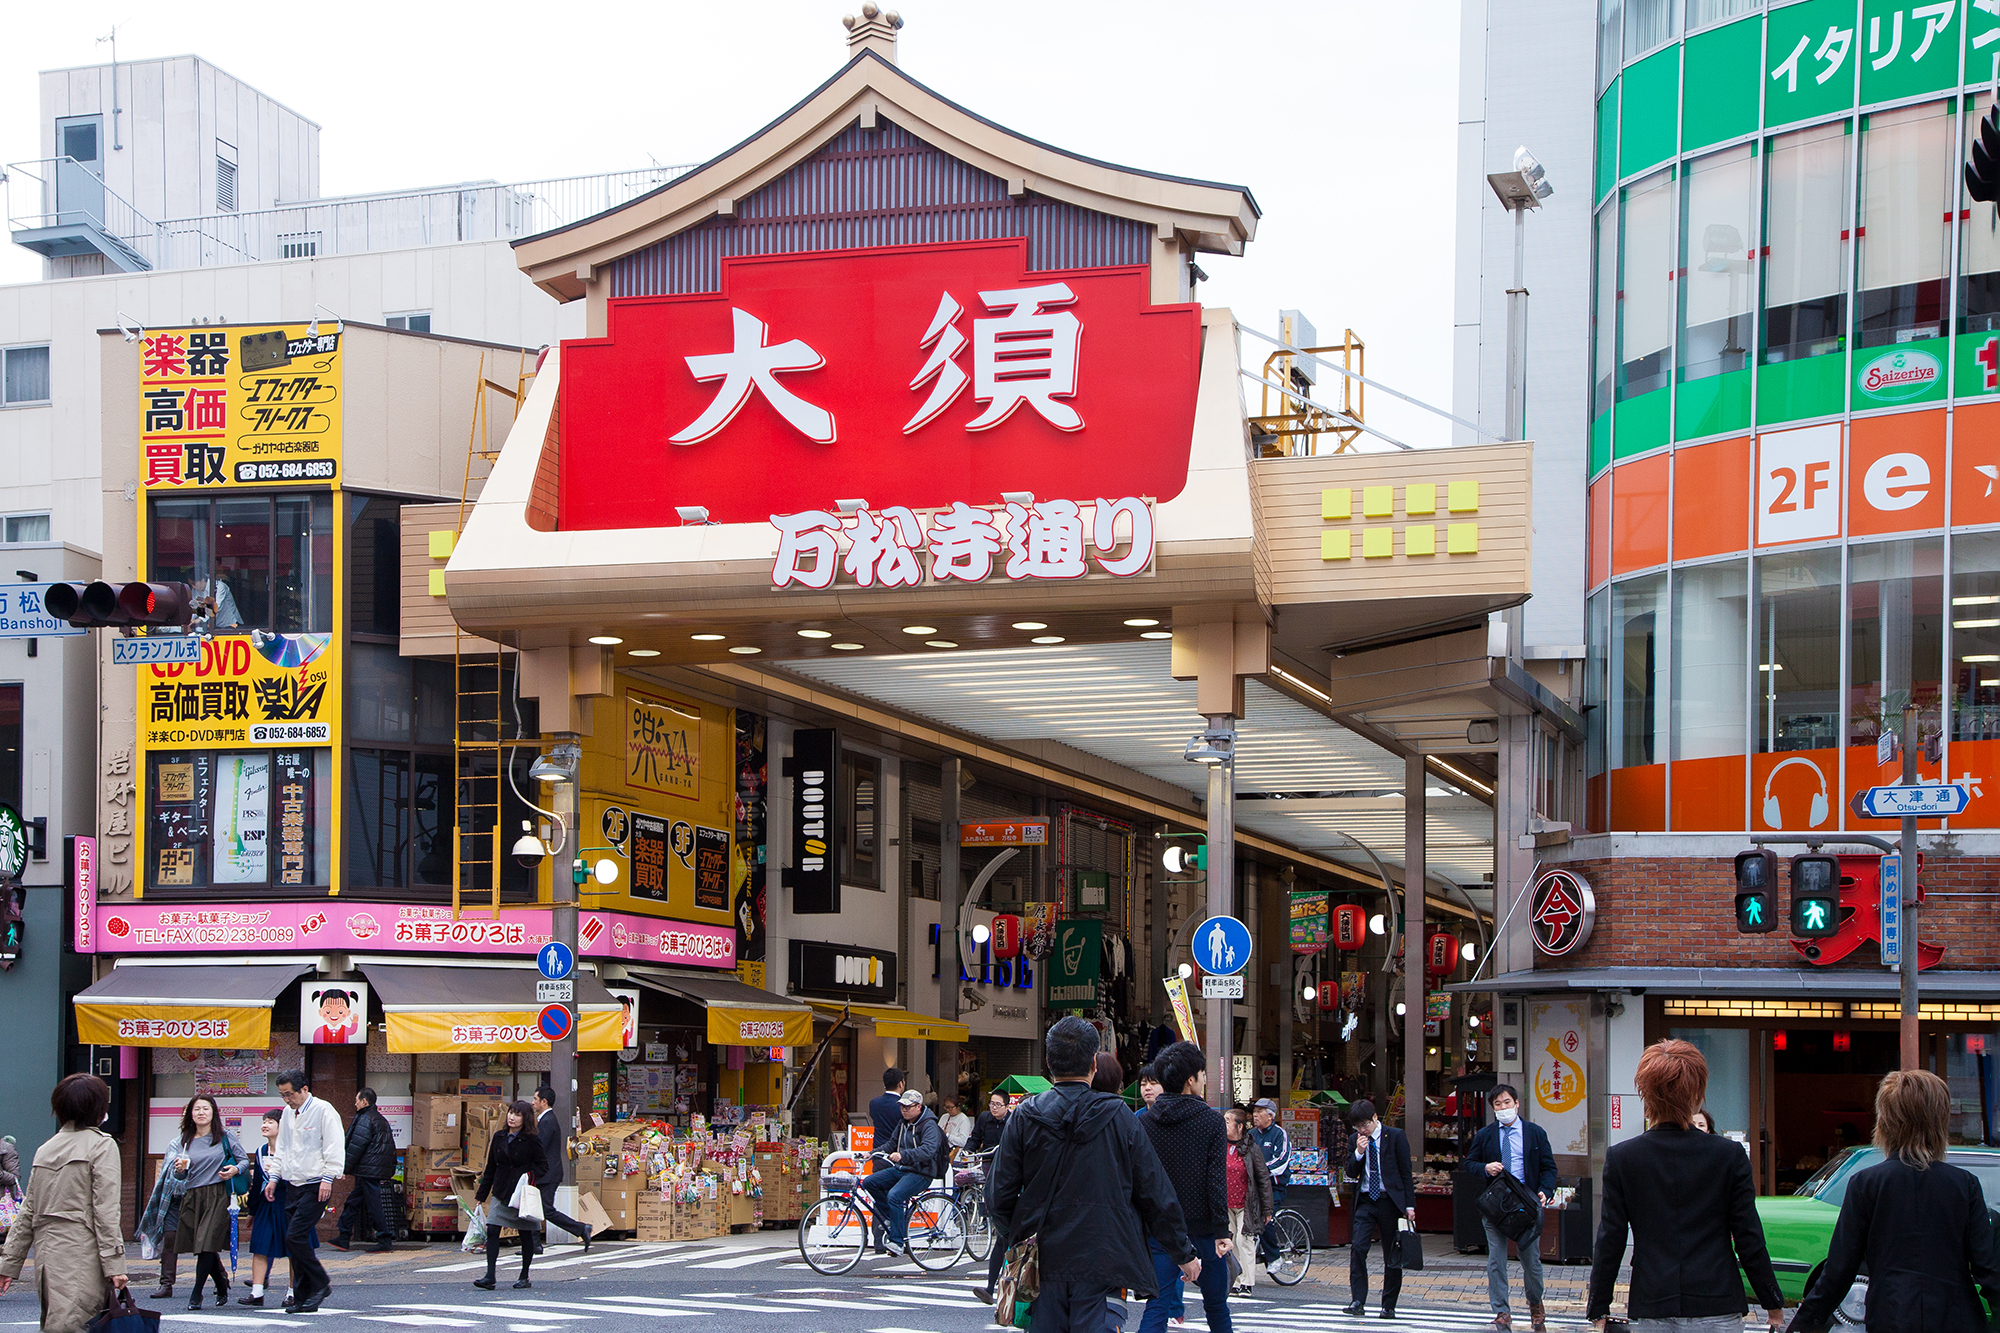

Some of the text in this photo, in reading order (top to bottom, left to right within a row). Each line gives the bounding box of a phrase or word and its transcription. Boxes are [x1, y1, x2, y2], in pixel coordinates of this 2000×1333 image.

[142, 331, 230, 378] 楽器
[287, 334, 335, 357] エフェクター専門店
[668, 282, 1087, 446] 大須
[1865, 367, 1935, 388] Saizeriya
[245, 377, 323, 403] エフェクター
[143, 388, 227, 433] 高価
[250, 406, 315, 431] フリークス
[252, 440, 319, 455] ガクヤ中古楽器店
[142, 442, 227, 487] 買取
[258, 462, 334, 478] 052-684-6853
[1768, 460, 1830, 515] 2F
[1863, 452, 1931, 511] e
[770, 496, 1156, 590] 万松寺通り
[116, 639, 197, 661] スクランブル式
[310, 670, 328, 683] OSU
[150, 681, 250, 722] 高価買取
[148, 728, 246, 743] 洋楽CD・DVD専門店
[269, 725, 327, 740] 052-684-6852
[277, 754, 300, 766] 名古屋
[287, 768, 310, 779] 唯一の
[198, 757, 209, 818] エフェクター
[244, 784, 268, 801] Fender
[1883, 789, 1951, 804] 大津通
[159, 812, 193, 823] ギター
[1897, 803, 1937, 812] Otsu-dori
[106, 751, 132, 895] 岩野屋ビル
[167, 824, 209, 837] & ベース
[607, 810, 624, 841] 2F
[802, 770, 827, 872] DOUTOR
[1025, 826, 1042, 835] B-5
[243, 830, 265, 841] ESP
[281, 783, 304, 884] 中古楽器専門店
[675, 826, 691, 854] 3F
[635, 837, 665, 866] 楽器
[635, 864, 664, 891] 買取
[79, 842, 91, 947] お菓子のひろば
[159, 909, 270, 925] お菓子・駄菓子ショップ
[1290, 900, 1329, 919] 当たる
[1885, 865, 1897, 955] 斜め横断専用
[395, 921, 525, 946] お菓子のひろば
[660, 930, 723, 959] お菓子のひろば
[836, 954, 884, 988] DOUTOR
[1205, 978, 1241, 987] 軽車両を除く
[538, 983, 571, 991] 軽車両を除く
[119, 1018, 229, 1039] お菓子のひろば
[452, 1025, 546, 1043] お菓子のひろ
[739, 1020, 784, 1039] お菓子のひろば
[770, 1046, 784, 1060] OPEN
[1552, 1060, 1561, 1100] 本家甘栗
